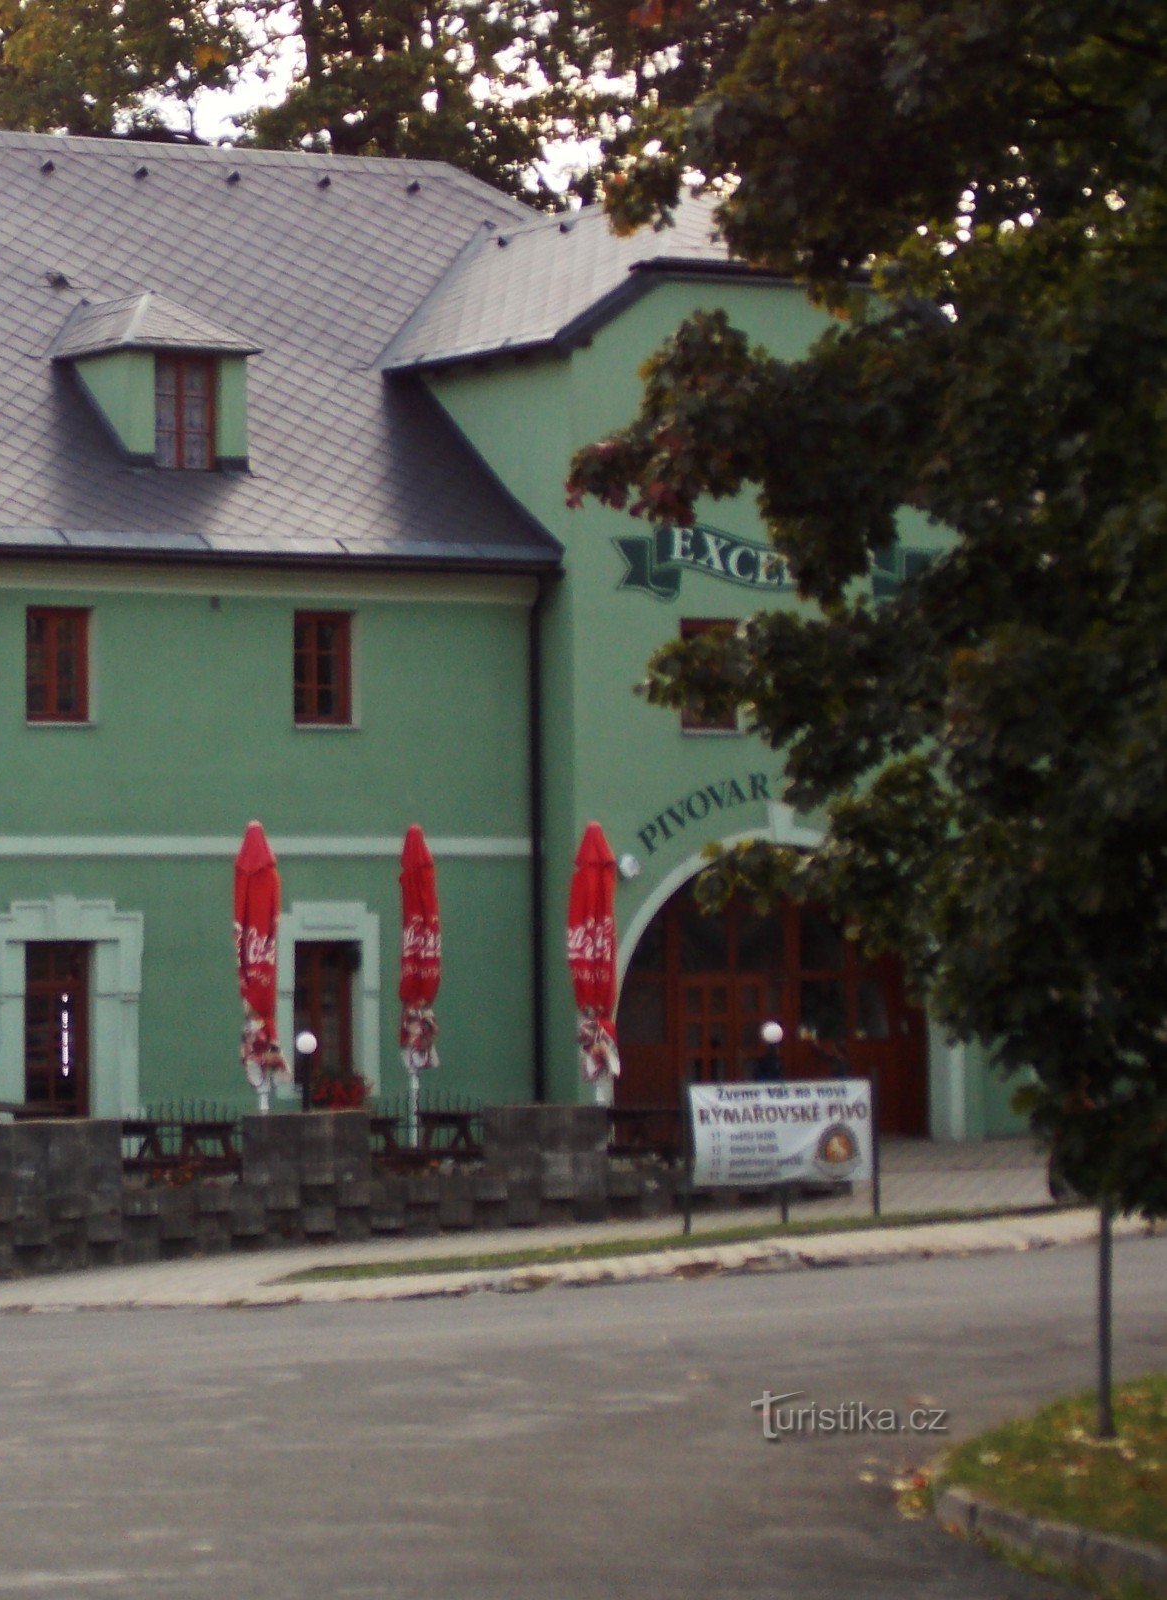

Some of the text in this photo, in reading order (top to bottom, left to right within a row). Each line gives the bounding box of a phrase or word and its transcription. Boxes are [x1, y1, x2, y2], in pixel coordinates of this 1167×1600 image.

[670, 526, 800, 586] EXCEL
[637, 772, 772, 855] PIVOVAR
[826, 1101, 867, 1121] PIVO
